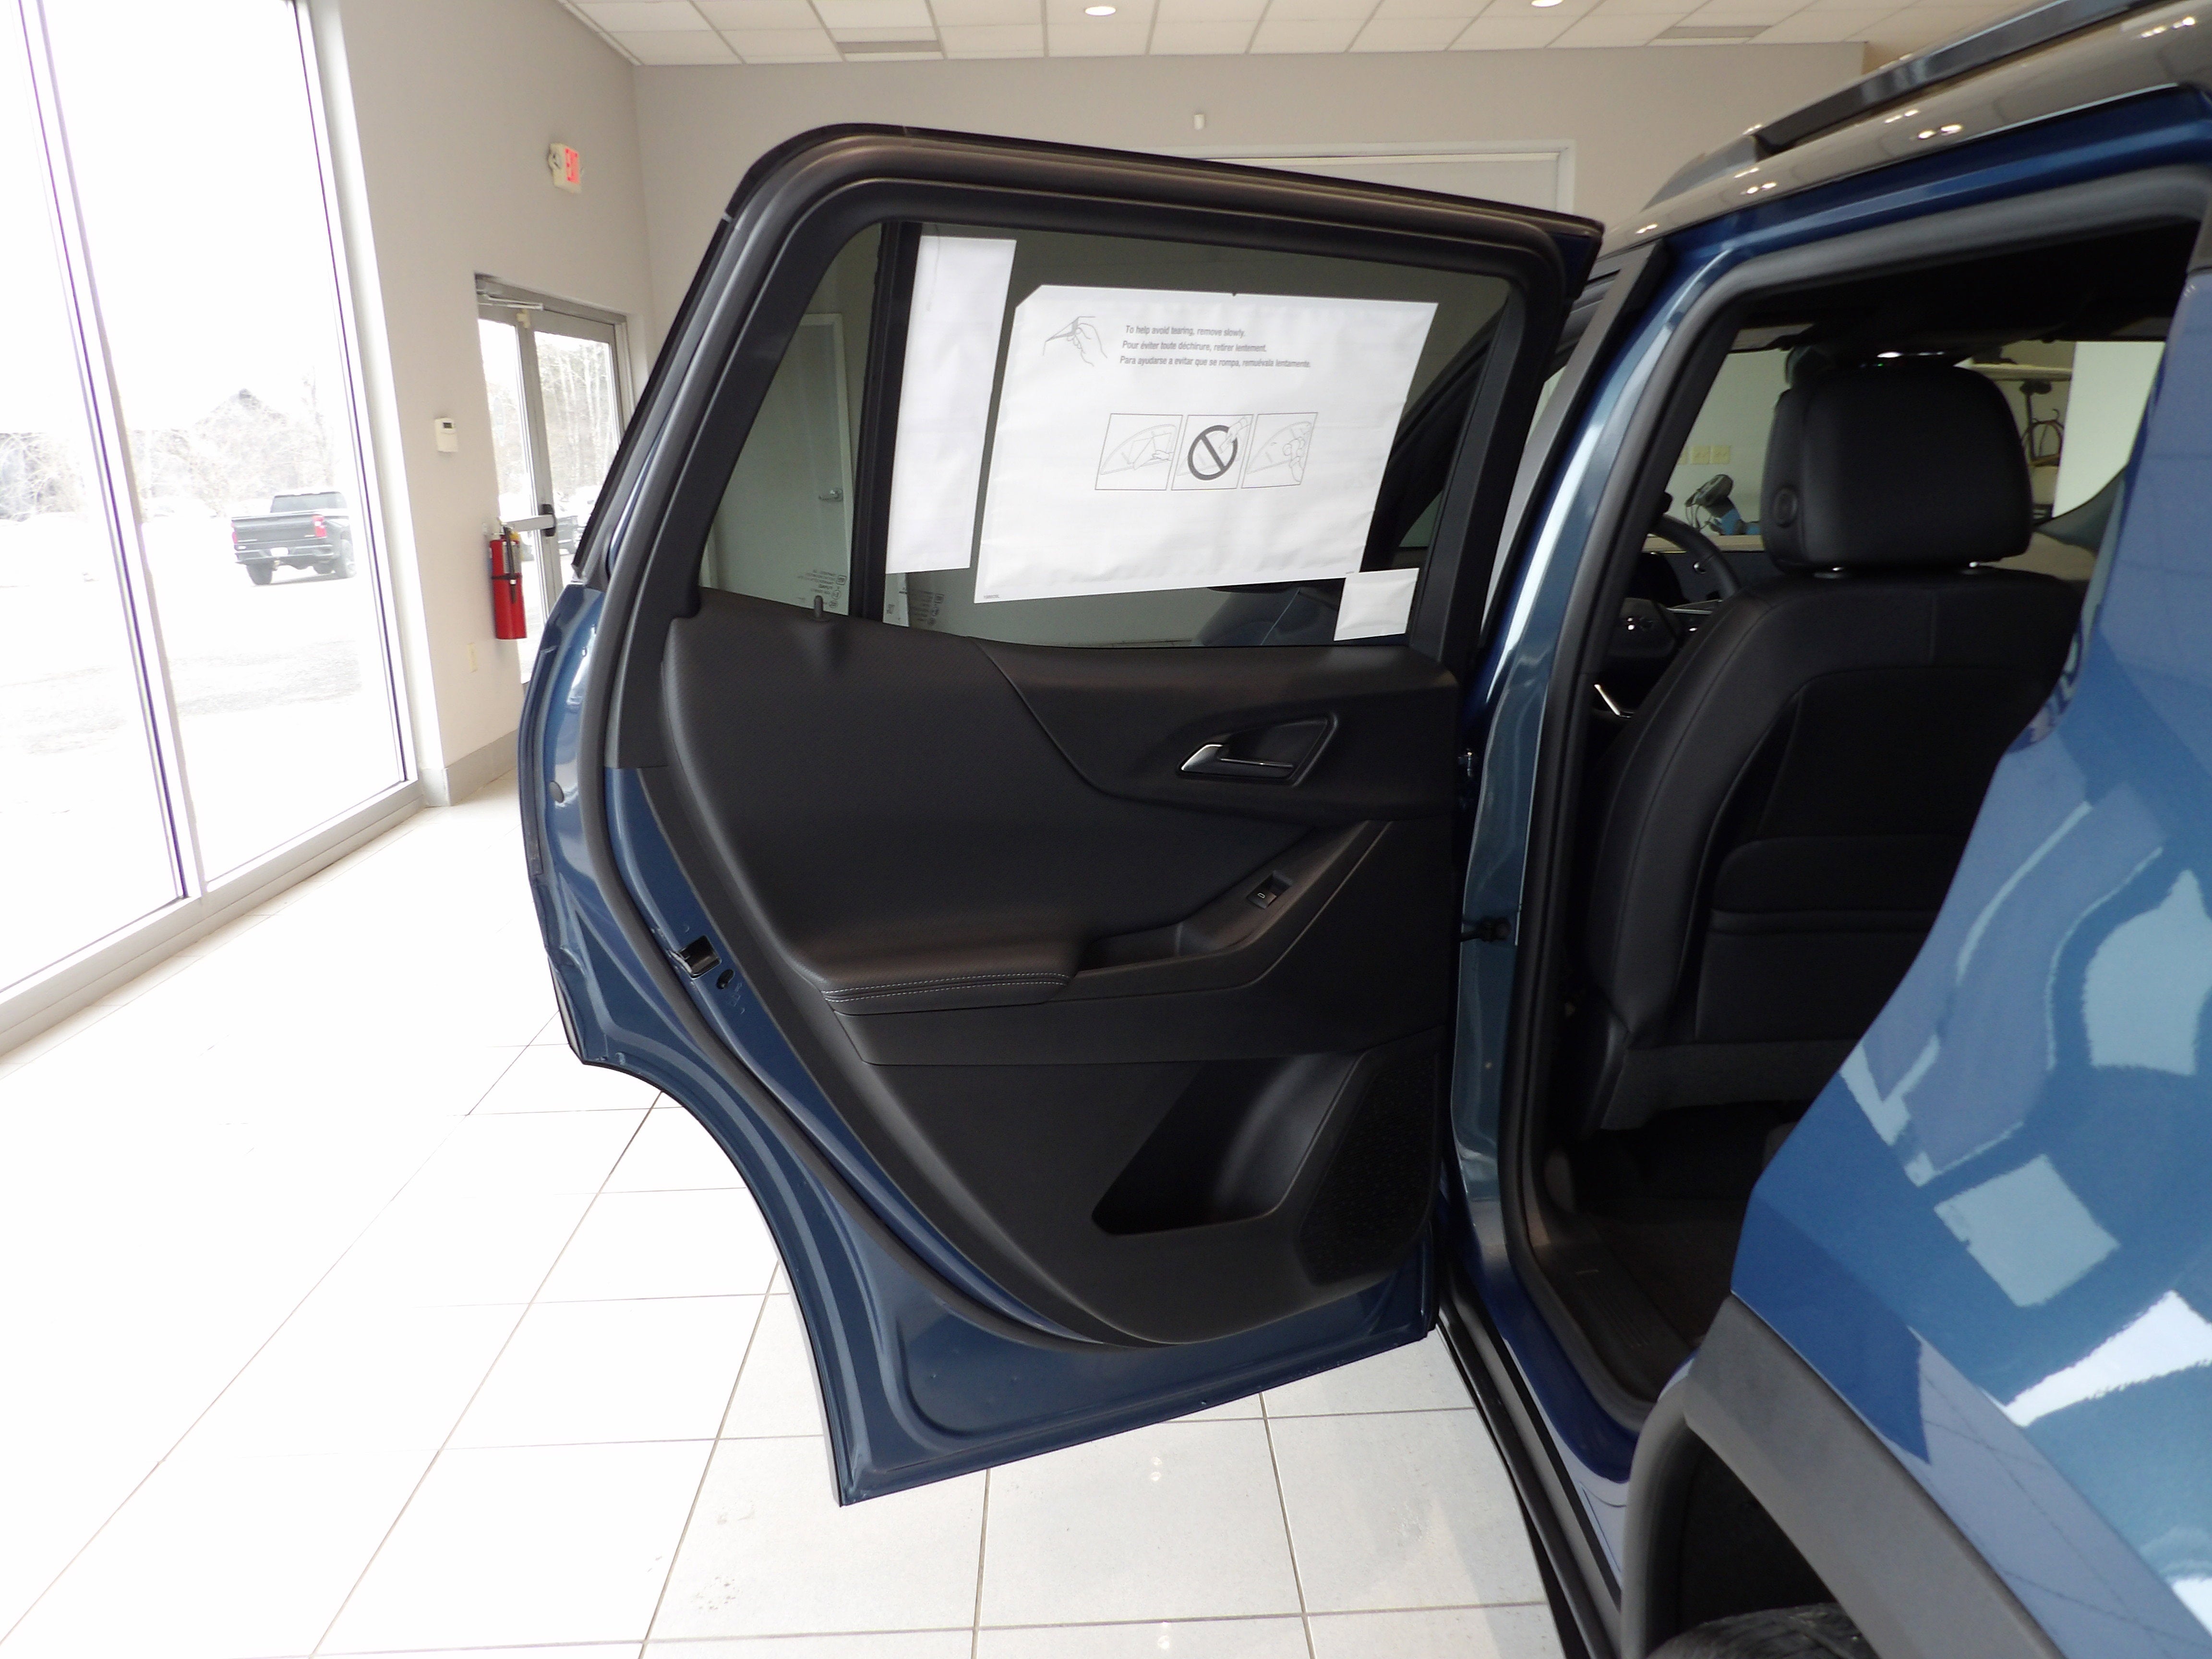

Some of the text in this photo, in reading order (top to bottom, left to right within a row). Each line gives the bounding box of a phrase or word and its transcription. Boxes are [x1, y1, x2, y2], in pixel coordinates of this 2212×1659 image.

[1126, 325, 1134, 334] To
[1136, 326, 1150, 335] help
[1122, 340, 1139, 349] Pour
[1140, 341, 1159, 349] éviter
[1178, 342, 1212, 352] déchirure,
[1119, 356, 1136, 364] Para
[1137, 357, 1167, 366] ayudarse
